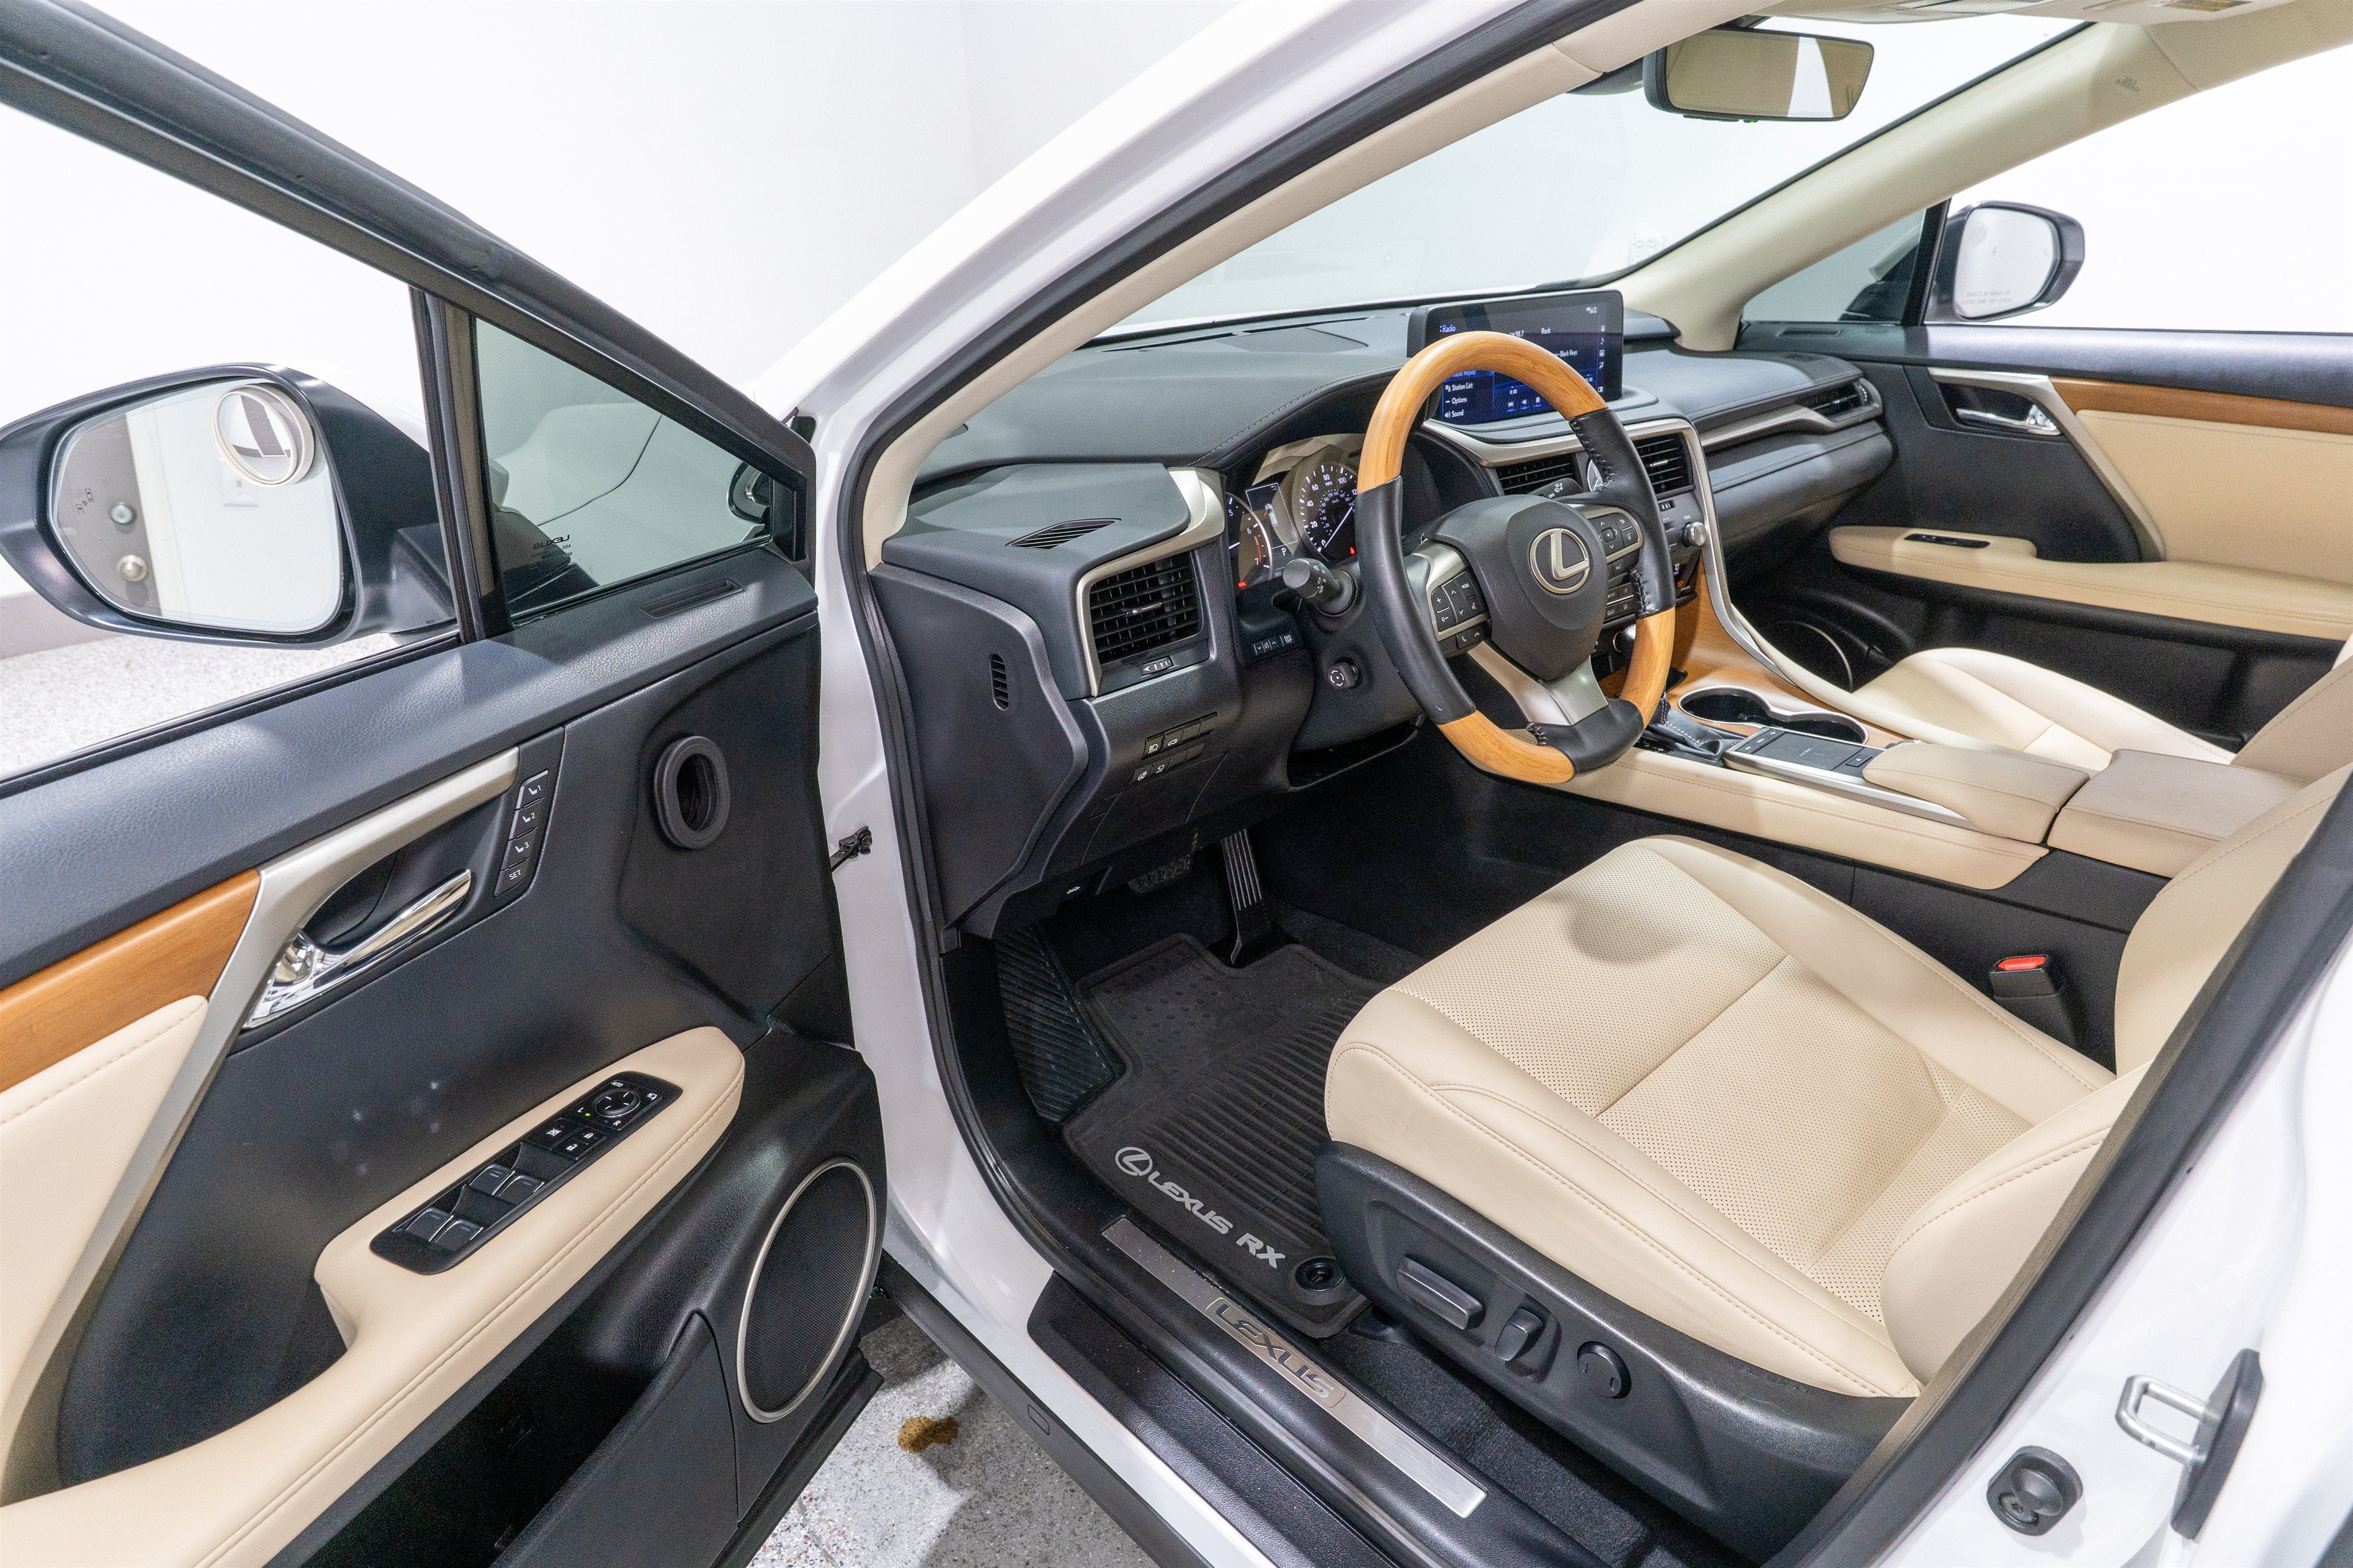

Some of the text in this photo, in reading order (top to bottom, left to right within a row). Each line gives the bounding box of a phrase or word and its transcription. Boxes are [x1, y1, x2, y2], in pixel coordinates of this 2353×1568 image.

[1442, 324, 1456, 333] Radio
[1451, 383, 1465, 391] Station
[1451, 397, 1467, 405] Options
[1451, 409, 1464, 418] Sound
[1281, 547, 1287, 556] P
[509, 869, 522, 880] SET
[1148, 1171, 1286, 1269] LEXUS RX
[1217, 1303, 1335, 1398] LEXUS
